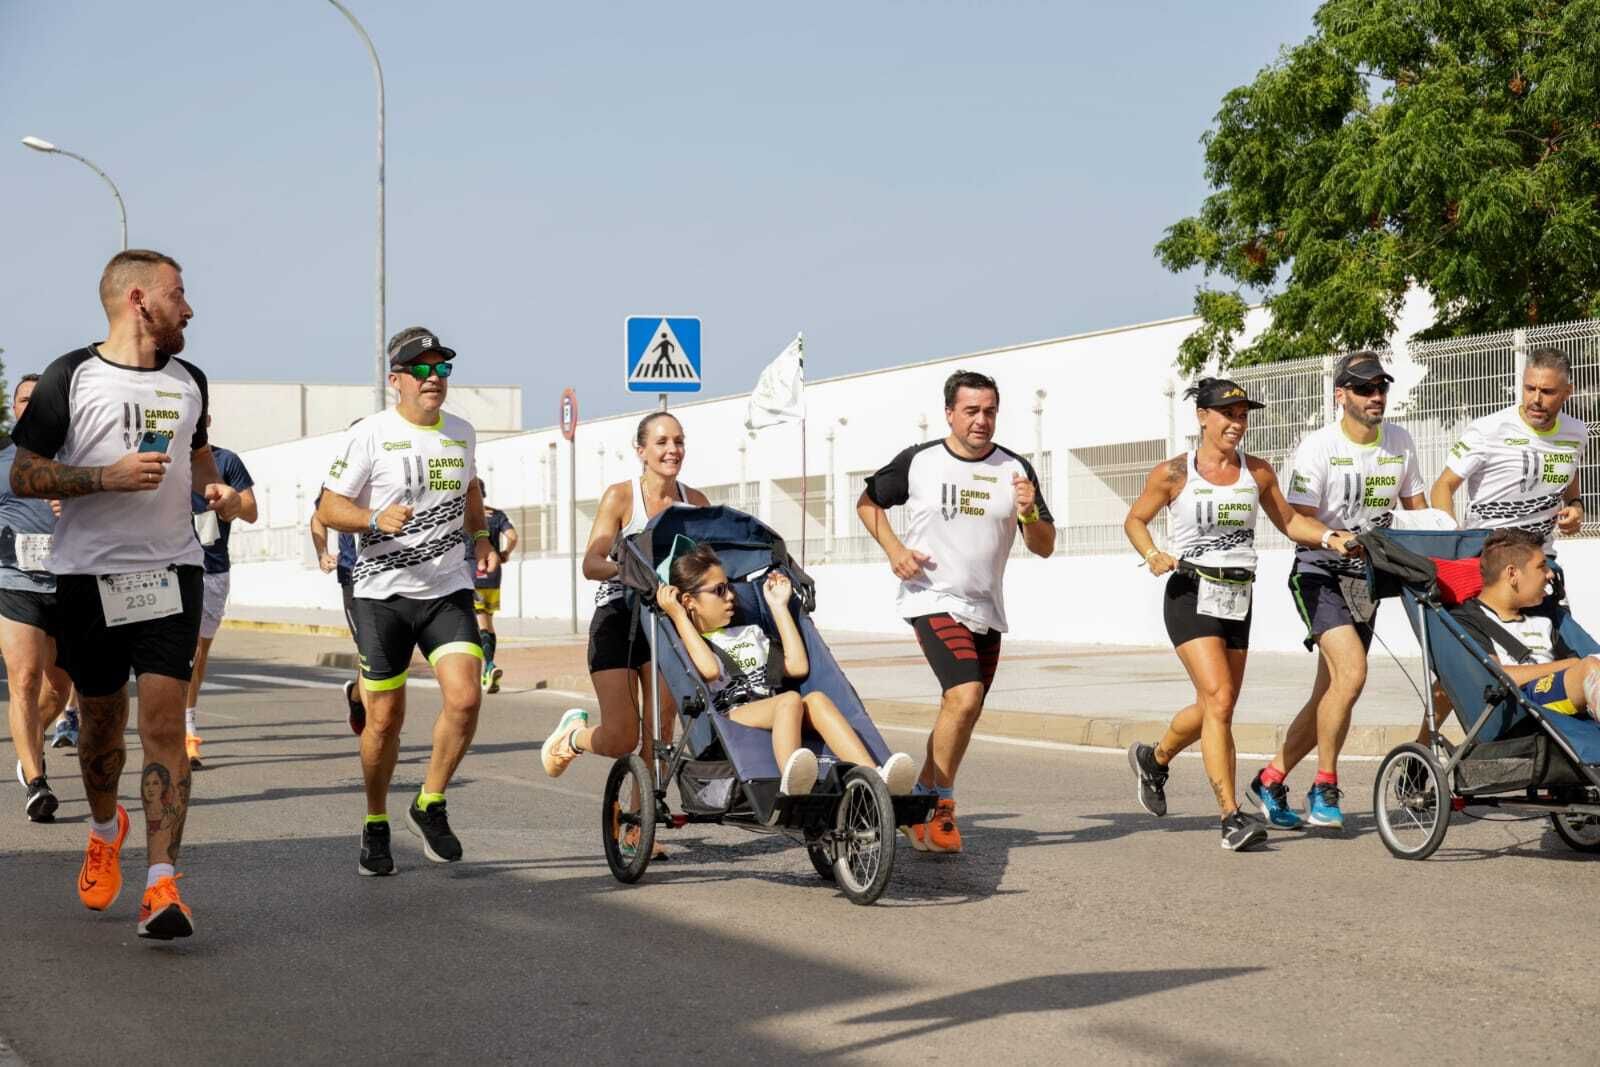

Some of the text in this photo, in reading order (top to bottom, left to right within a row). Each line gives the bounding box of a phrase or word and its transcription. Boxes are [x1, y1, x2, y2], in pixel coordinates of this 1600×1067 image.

[144, 409, 180, 419] CARROS
[145, 420, 157, 429] DE
[428, 458, 465, 468] CARROS
[1544, 454, 1574, 464] CARROS
[1543, 464, 1555, 473] DE
[429, 470, 442, 479] DE
[1542, 475, 1569, 483] FUEGO
[429, 481, 462, 491] FUEGO
[1365, 476, 1396, 486] CARROS
[960, 490, 990, 500] CARROS
[1365, 488, 1375, 496] DE
[960, 498, 970, 506] DE
[1363, 498, 1390, 507] FUEGO
[960, 506, 985, 516] FUEGO
[126, 593, 157, 610] 239
